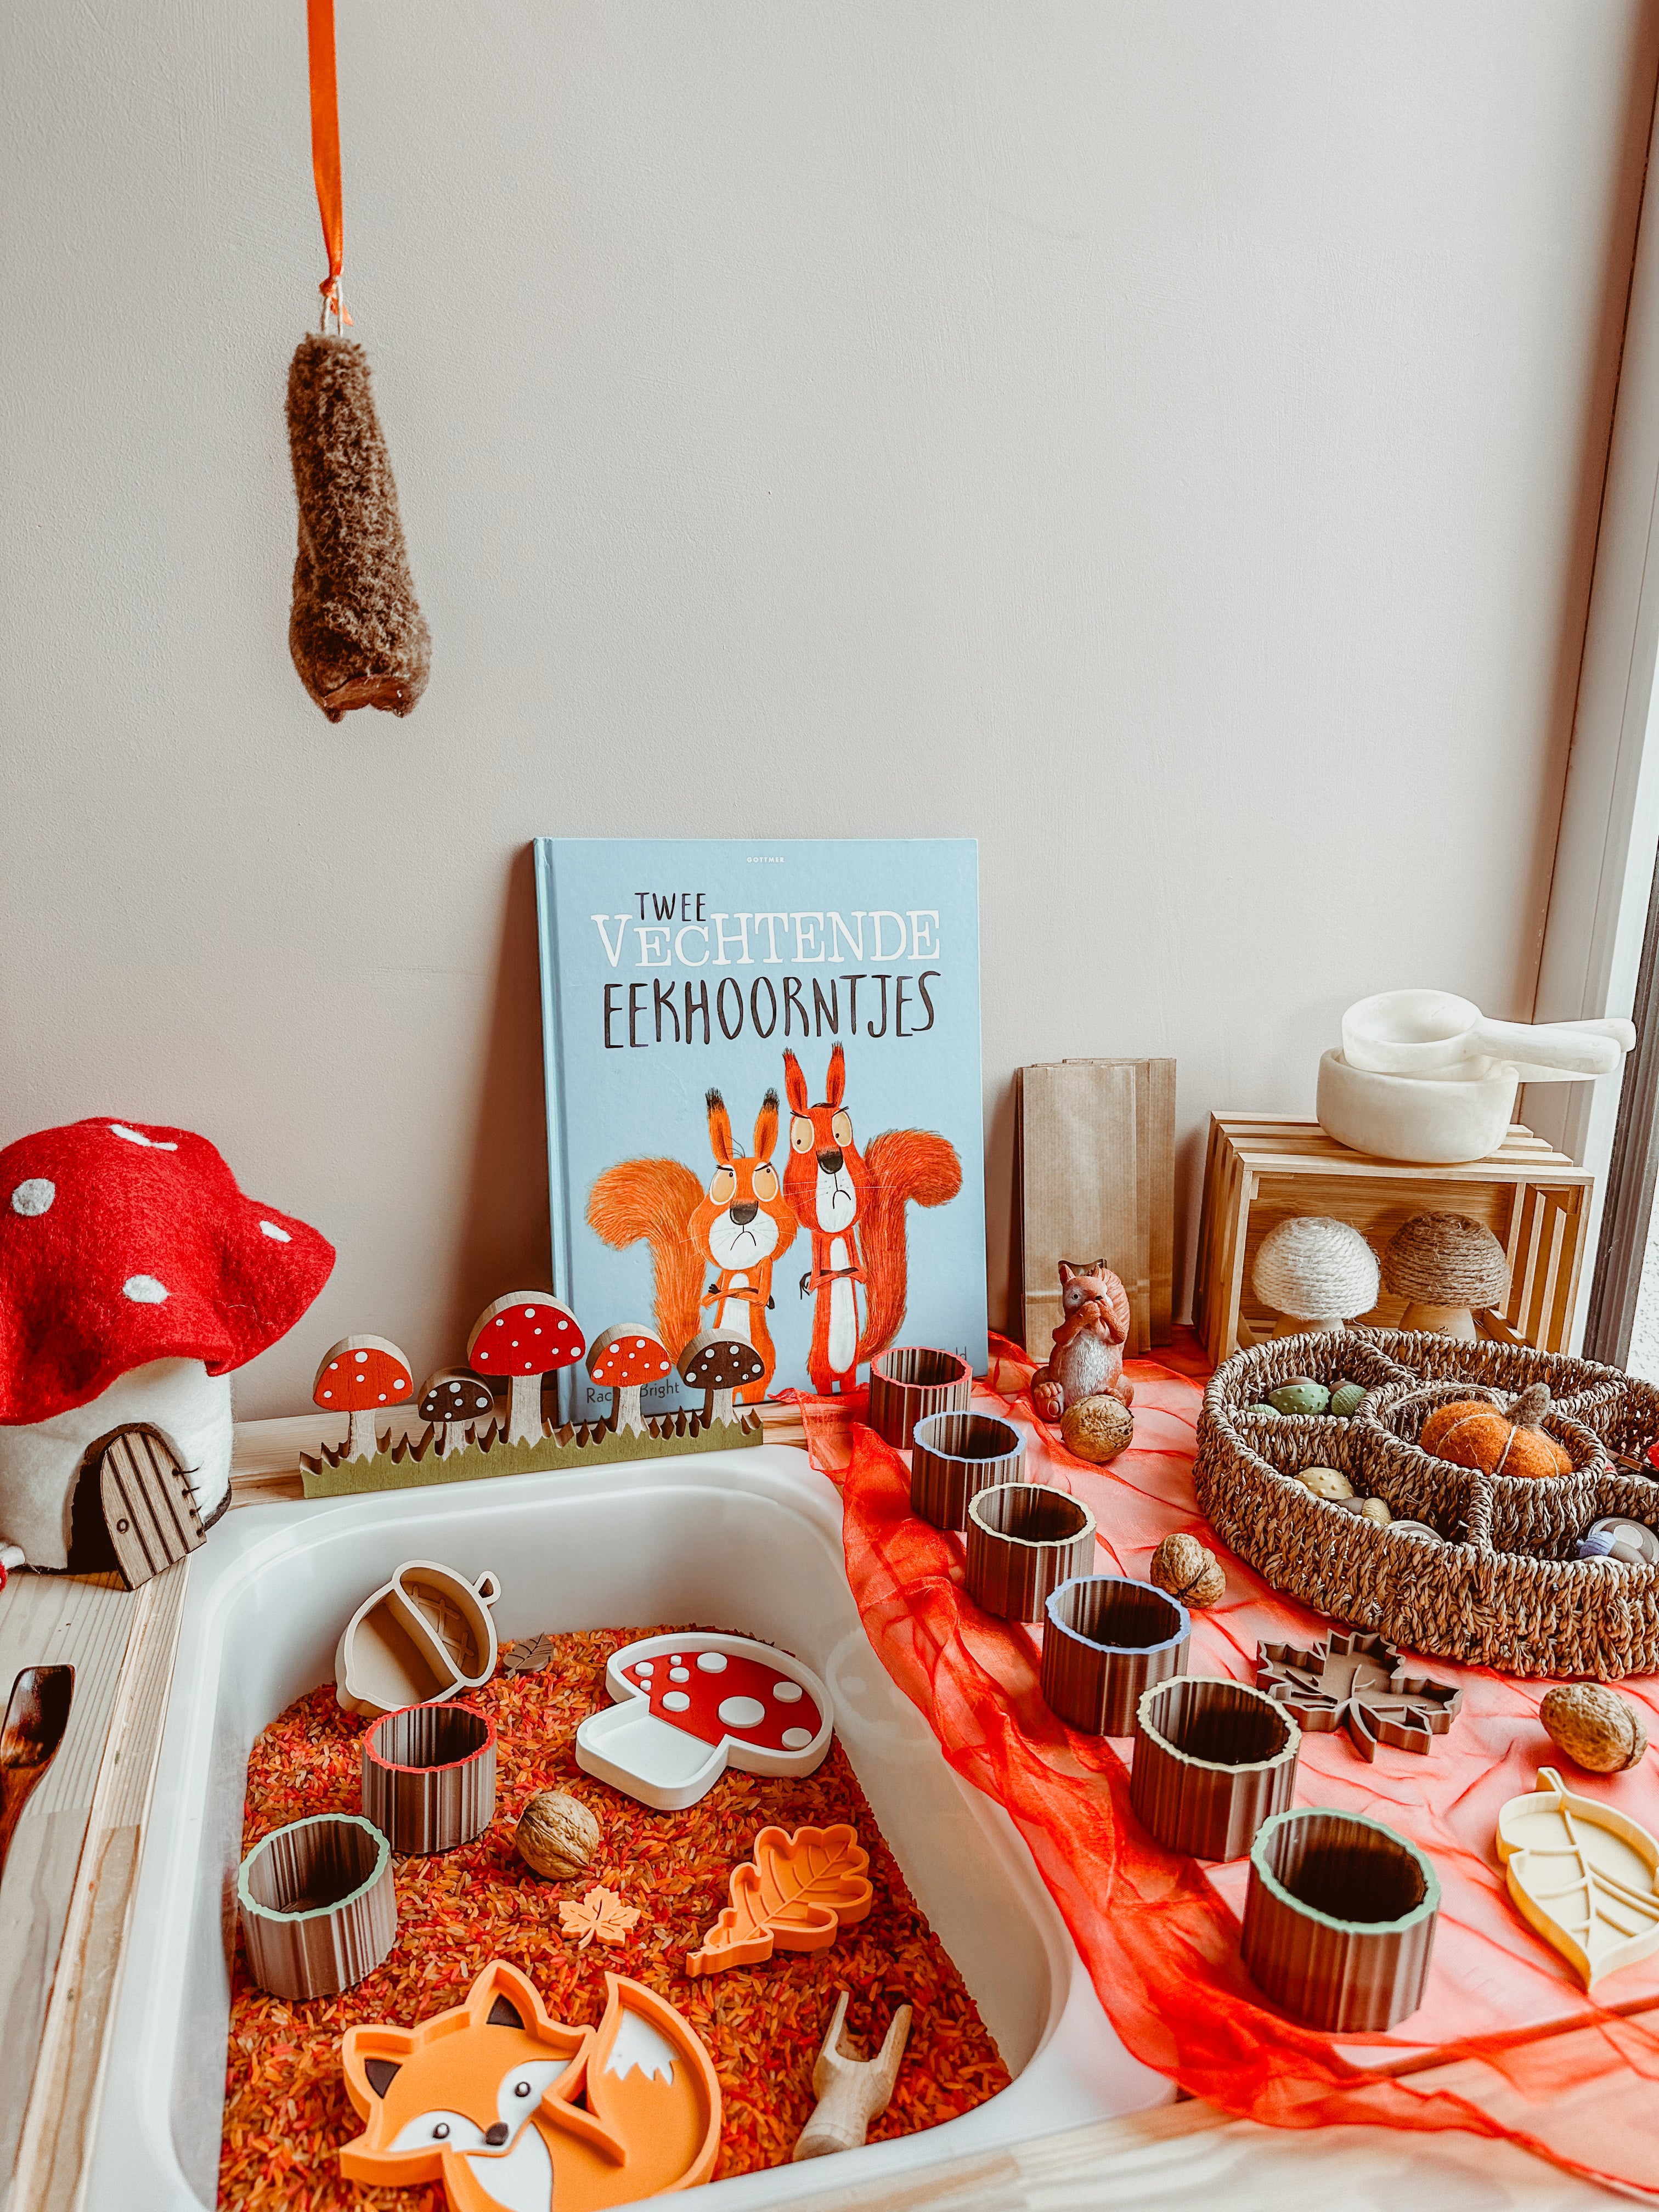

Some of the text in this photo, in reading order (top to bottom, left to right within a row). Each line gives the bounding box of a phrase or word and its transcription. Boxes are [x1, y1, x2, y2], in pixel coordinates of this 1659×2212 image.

[635, 892, 707, 922] TWEE
[591, 910, 941, 967] VECHTENDE
[604, 970, 941, 1049] EEKHOORNTJES
[586, 1378, 680, 1403] Rac Bright
